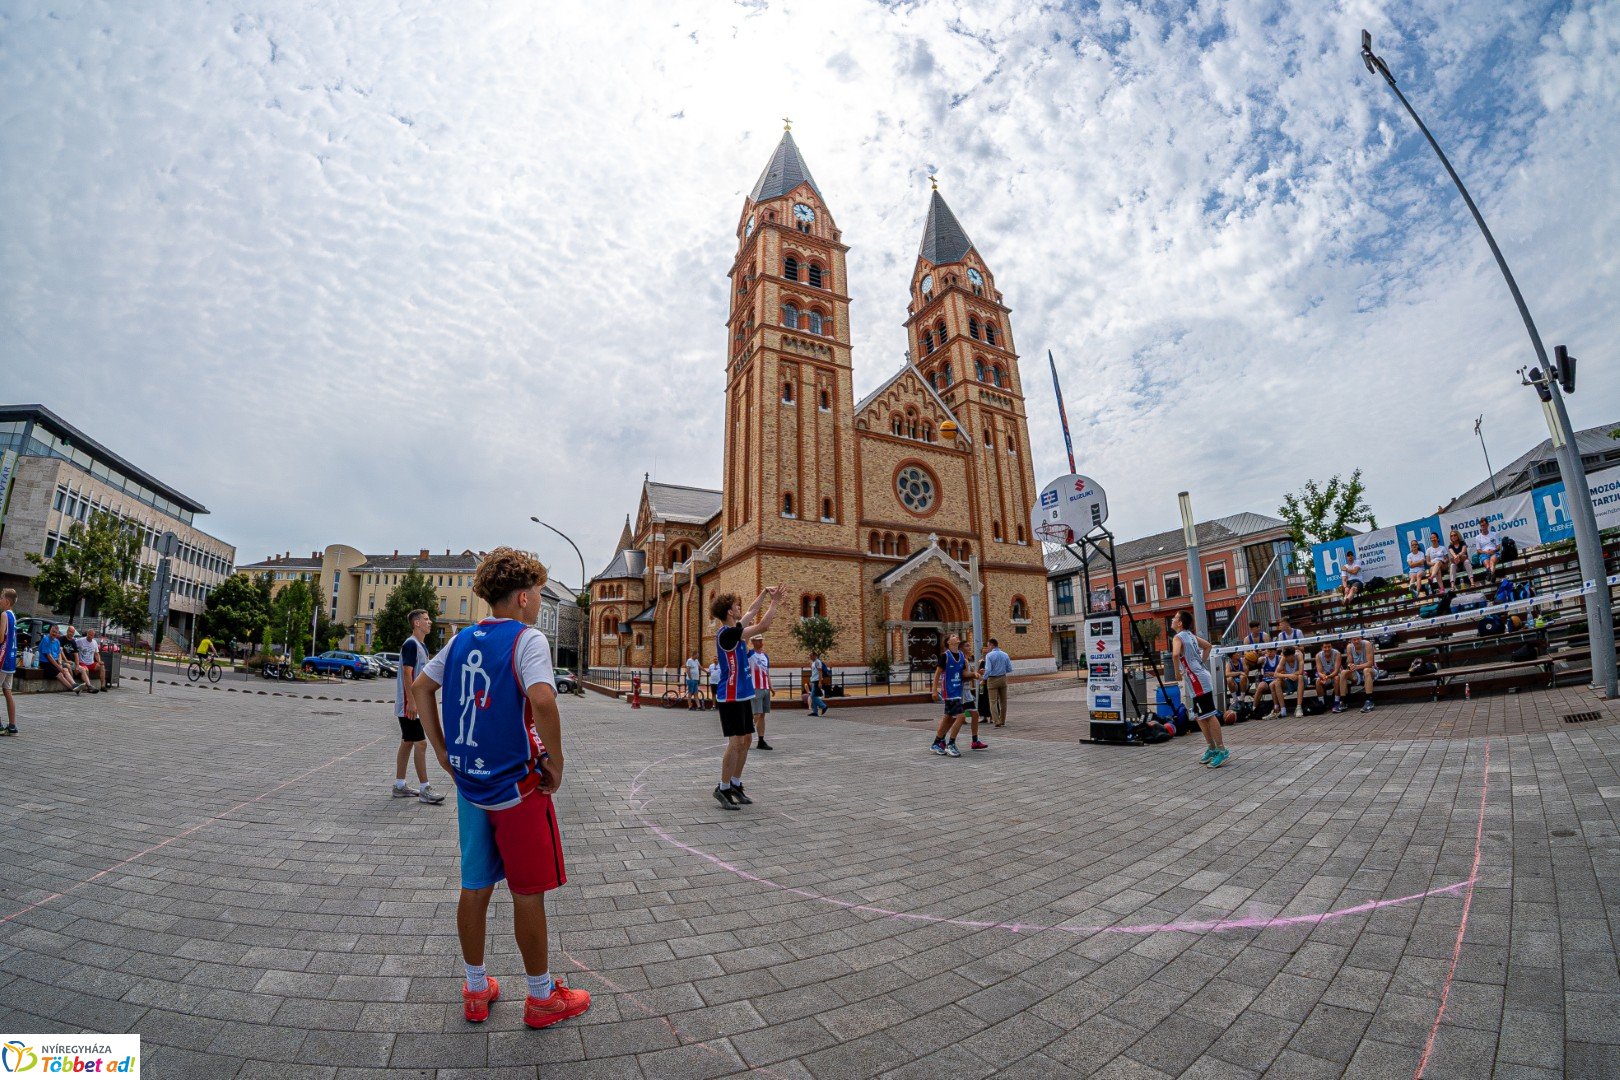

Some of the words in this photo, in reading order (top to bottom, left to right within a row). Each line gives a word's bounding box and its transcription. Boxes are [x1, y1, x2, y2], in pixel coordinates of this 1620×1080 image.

[1069, 490, 1094, 501] SUZUKI
[1052, 510, 1058, 519] 8
[1450, 512, 1504, 532] MOZGÁBAN
[1490, 525, 1496, 533] A
[1358, 539, 1395, 552] MOZGÁSBAN
[1360, 549, 1385, 559] TARTJUK
